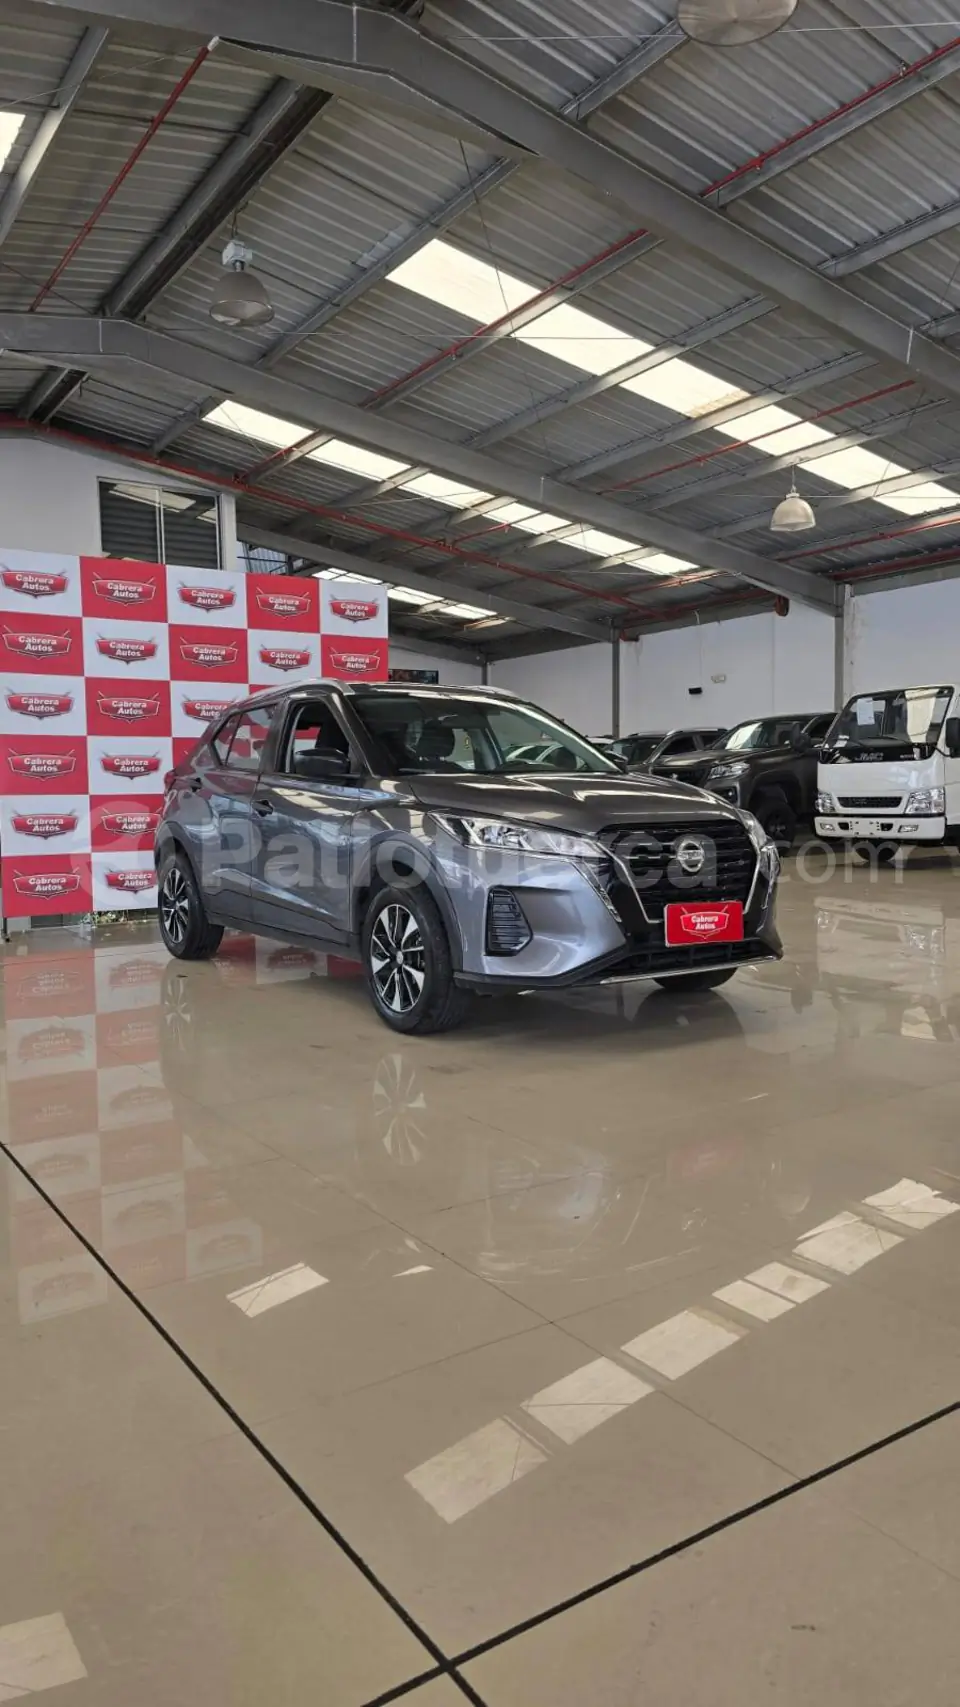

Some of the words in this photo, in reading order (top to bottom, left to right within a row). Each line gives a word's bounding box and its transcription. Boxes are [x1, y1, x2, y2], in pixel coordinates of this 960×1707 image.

[16, 574, 54, 585] Cabrera
[22, 582, 50, 591] Autos
[107, 582, 143, 592] Cabrera
[113, 590, 139, 598] Autos
[191, 590, 224, 599] Cabrera
[268, 596, 300, 606] Cabrera
[340, 603, 369, 611] Cabrera
[18, 635, 57, 645] Cabrera
[25, 643, 53, 652] Autos
[109, 641, 145, 651] Cabrera
[115, 649, 141, 657] Autos
[192, 646, 226, 655] Cabrera
[198, 653, 223, 661] Autos
[270, 651, 301, 660] Cabrera
[341, 655, 370, 664] Cabrera
[21, 697, 59, 706] Cabrera
[111, 700, 147, 708] Cabrera
[27, 704, 55, 712] Autos
[117, 707, 144, 715] Autos
[24, 757, 62, 765] Cabrera
[113, 758, 149, 766] Cabrera
[30, 764, 58, 772] Autos
[119, 765, 145, 773] Autos
[26, 817, 64, 825] Cabrera
[115, 815, 151, 823] Cabrera
[32, 824, 61, 832] Autos
[121, 822, 147, 830] Autos
[29, 877, 66, 885] Cabrera
[117, 873, 152, 881] Cabrera
[123, 879, 149, 887] Autos
[35, 883, 63, 892] Autos
[691, 915, 719, 923] Cabrera
[695, 922, 716, 930] Autos
